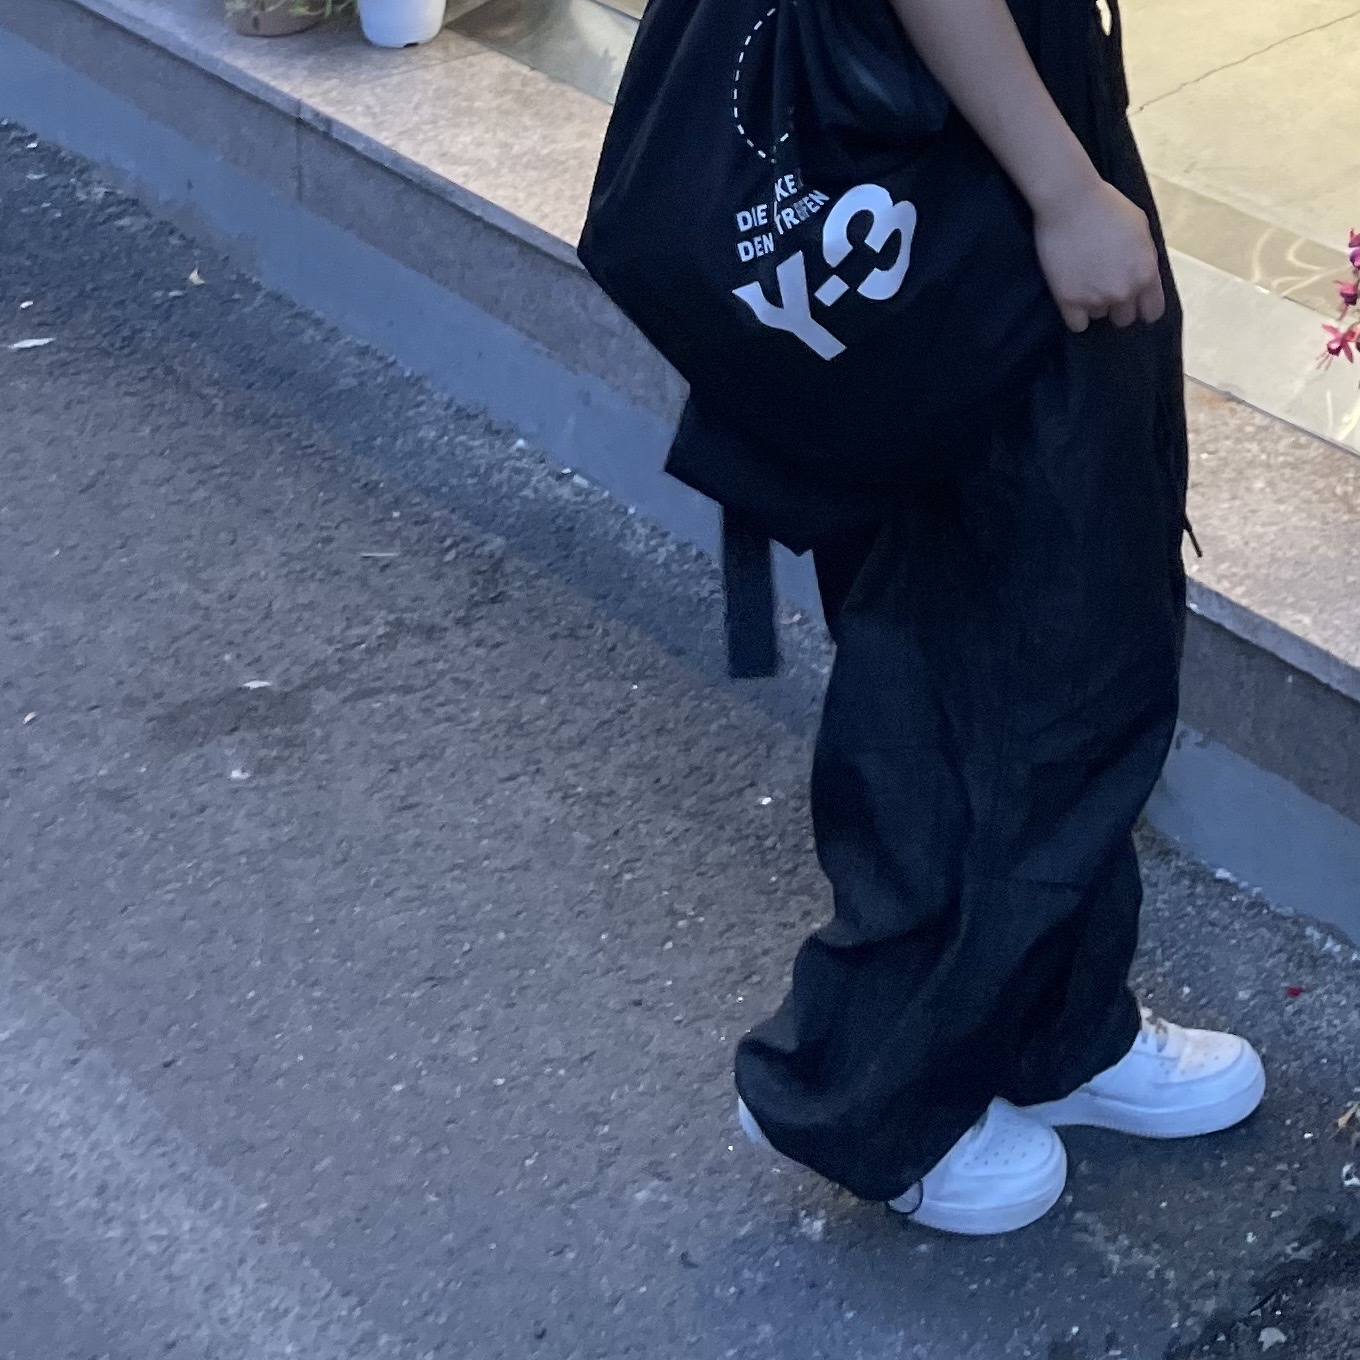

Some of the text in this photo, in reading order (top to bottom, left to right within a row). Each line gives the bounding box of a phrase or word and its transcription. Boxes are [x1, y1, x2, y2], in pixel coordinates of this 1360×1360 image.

[736, 203, 768, 232] DIE
[737, 232, 774, 262] DEN
[731, 182, 918, 362] Y-3
